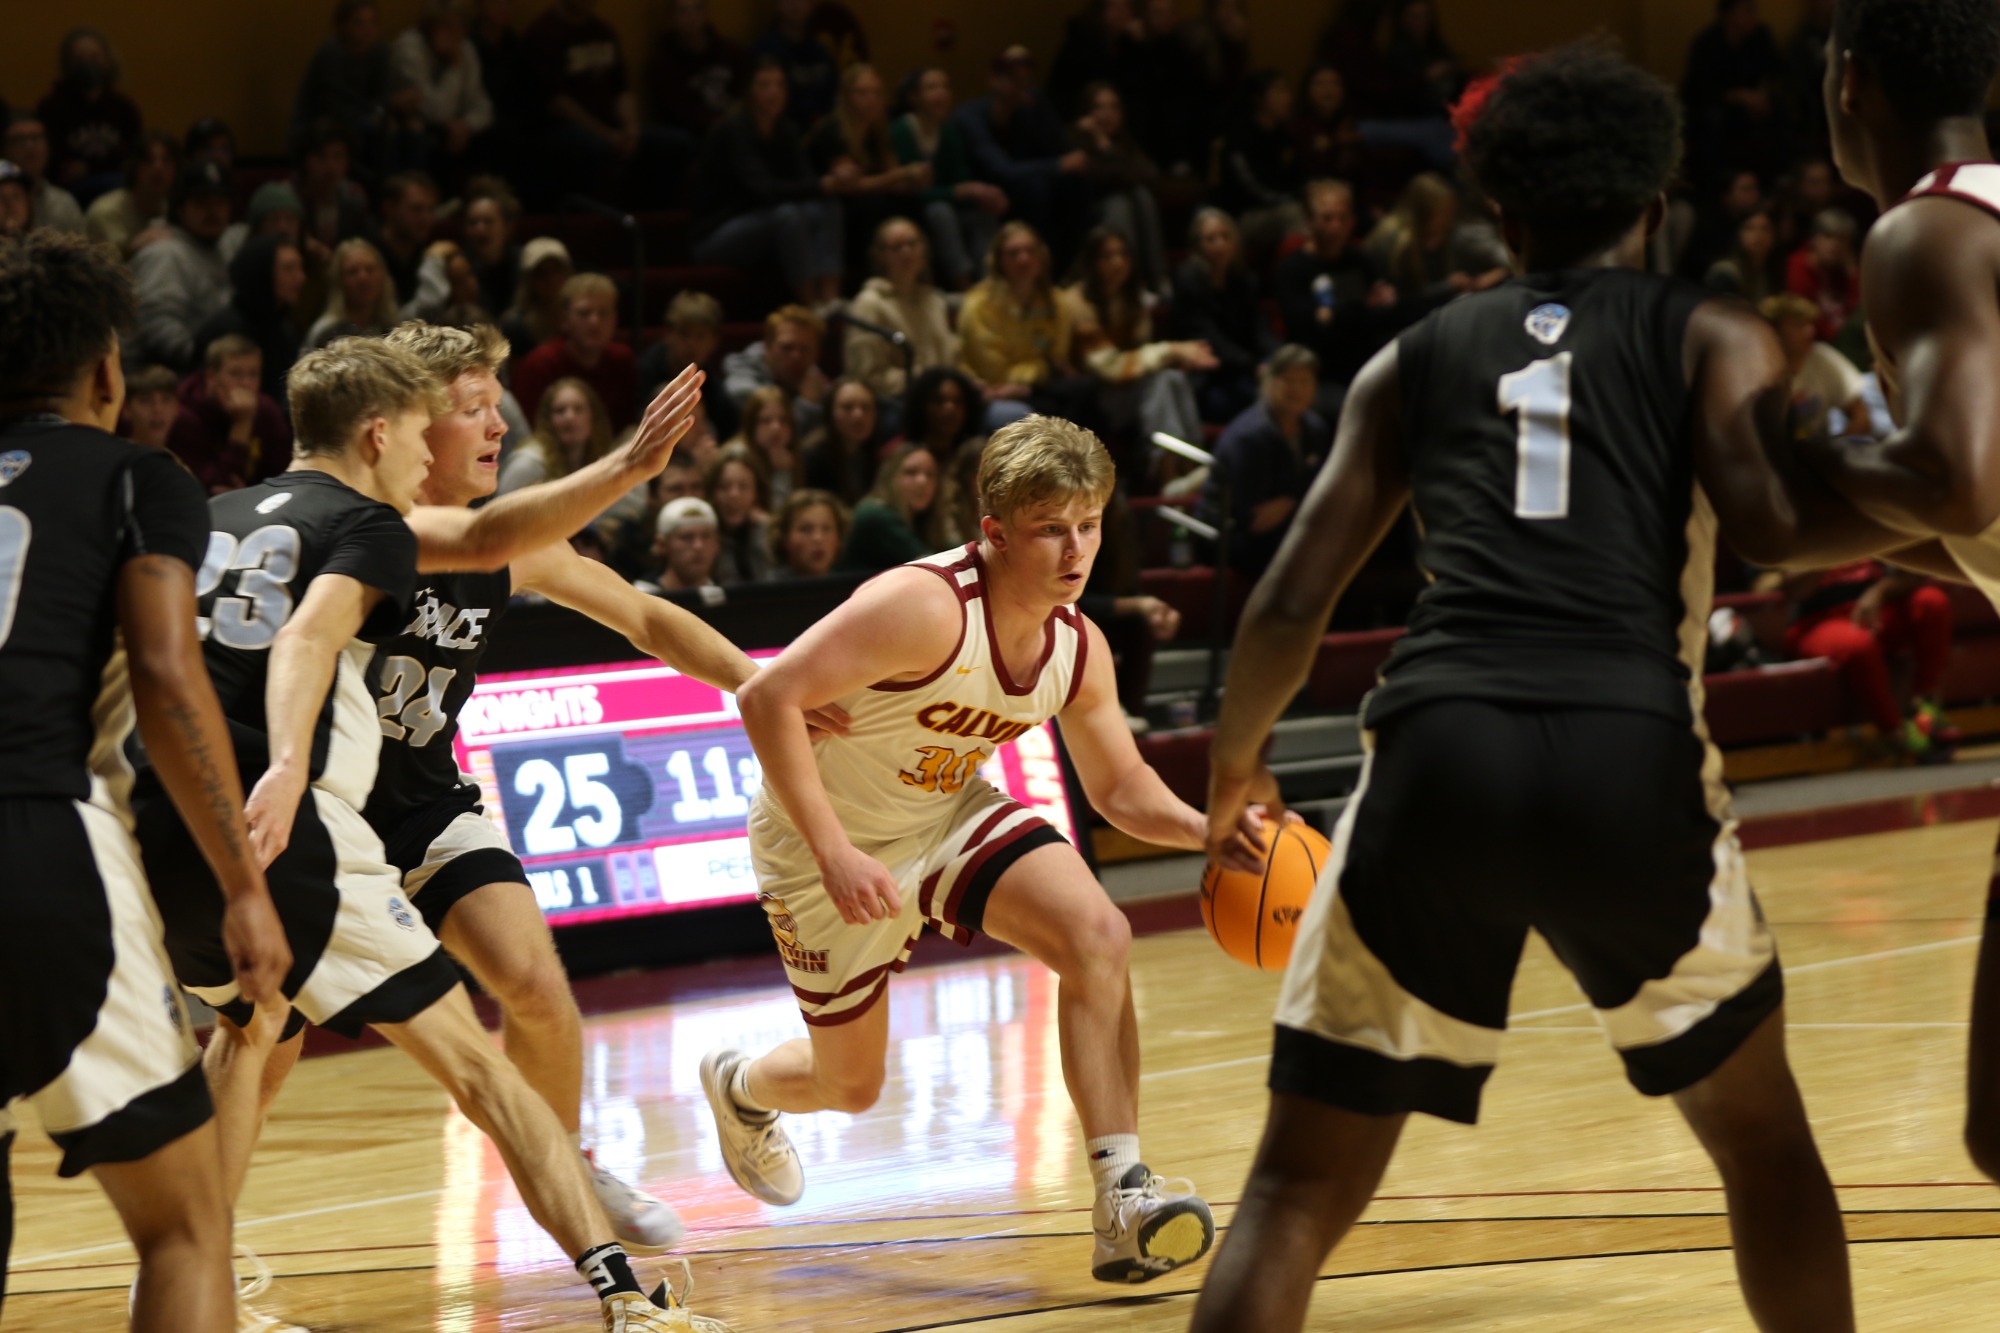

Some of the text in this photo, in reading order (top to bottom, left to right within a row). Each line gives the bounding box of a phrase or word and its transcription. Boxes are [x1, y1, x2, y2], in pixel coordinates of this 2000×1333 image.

[1498, 351, 1572, 518] 1
[401, 590, 490, 650] RACE
[379, 655, 457, 747] 24
[464, 684, 603, 736] KNIGHTS
[514, 753, 622, 855] 25
[898, 746, 987, 793] 30
